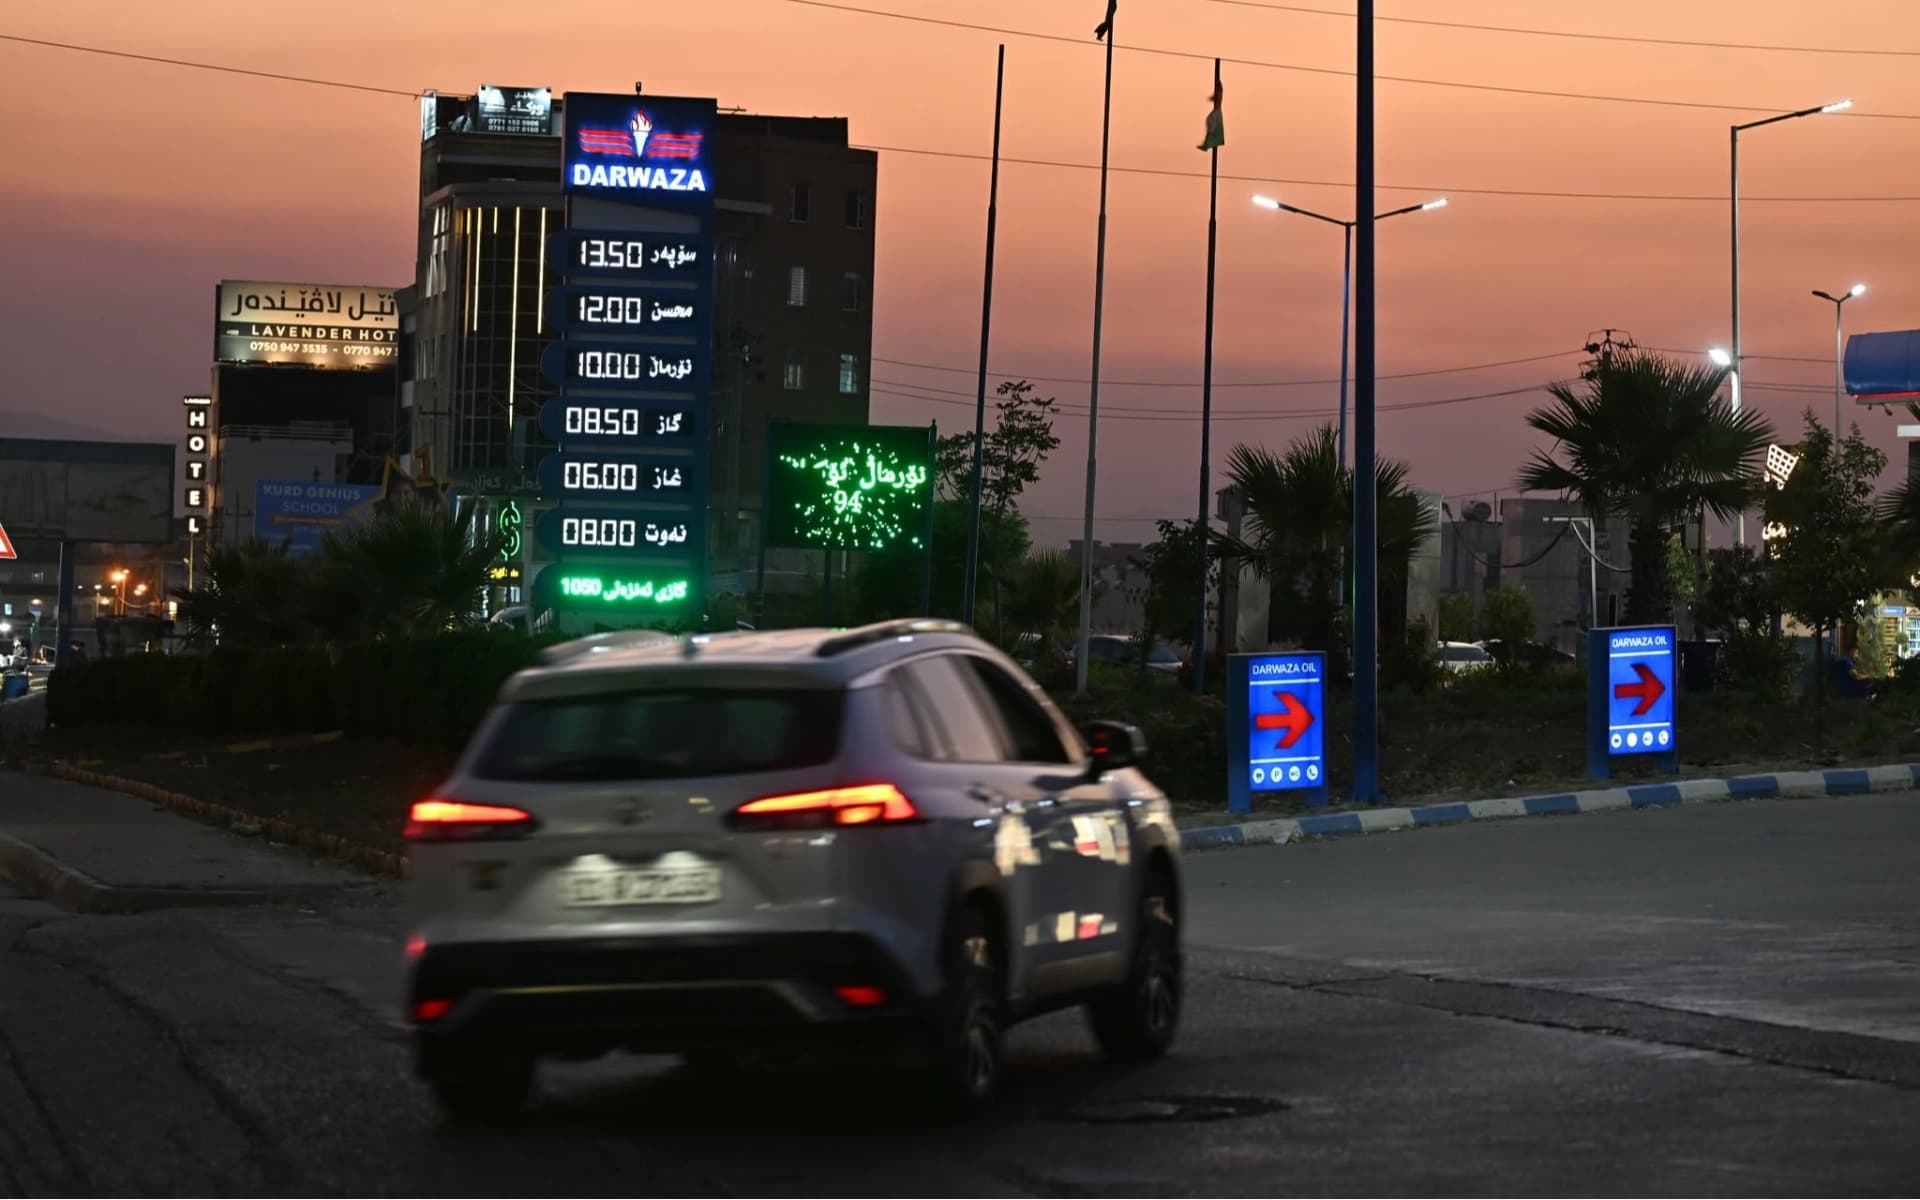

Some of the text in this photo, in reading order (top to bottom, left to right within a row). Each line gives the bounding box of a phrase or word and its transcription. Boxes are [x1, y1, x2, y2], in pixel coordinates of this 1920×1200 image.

[573, 163, 706, 192] DARWAZA
[580, 240, 697, 269] سۆپەر 13.50
[579, 296, 642, 323] 12.00
[251, 324, 353, 341] LAVENDER
[250, 341, 278, 352] 0750
[279, 342, 300, 353] 947
[302, 343, 329, 354] 3535
[343, 345, 371, 355] 0770
[372, 347, 392, 357] 947
[577, 351, 640, 379] 10.00
[565, 407, 683, 435] گاز 08.50
[189, 411, 206, 533] HOTEL
[564, 462, 638, 491] 06.00
[653, 468, 682, 489] غاز
[263, 484, 361, 501] KURD GENIUS
[833, 490, 863, 514] 94
[281, 501, 339, 514] SCHOOL
[563, 518, 687, 547] نەوت 08.00
[560, 577, 602, 595] 1050
[1612, 635, 1668, 648] DARWAZA OIL
[1252, 662, 1316, 675] DARWAZA OIL
